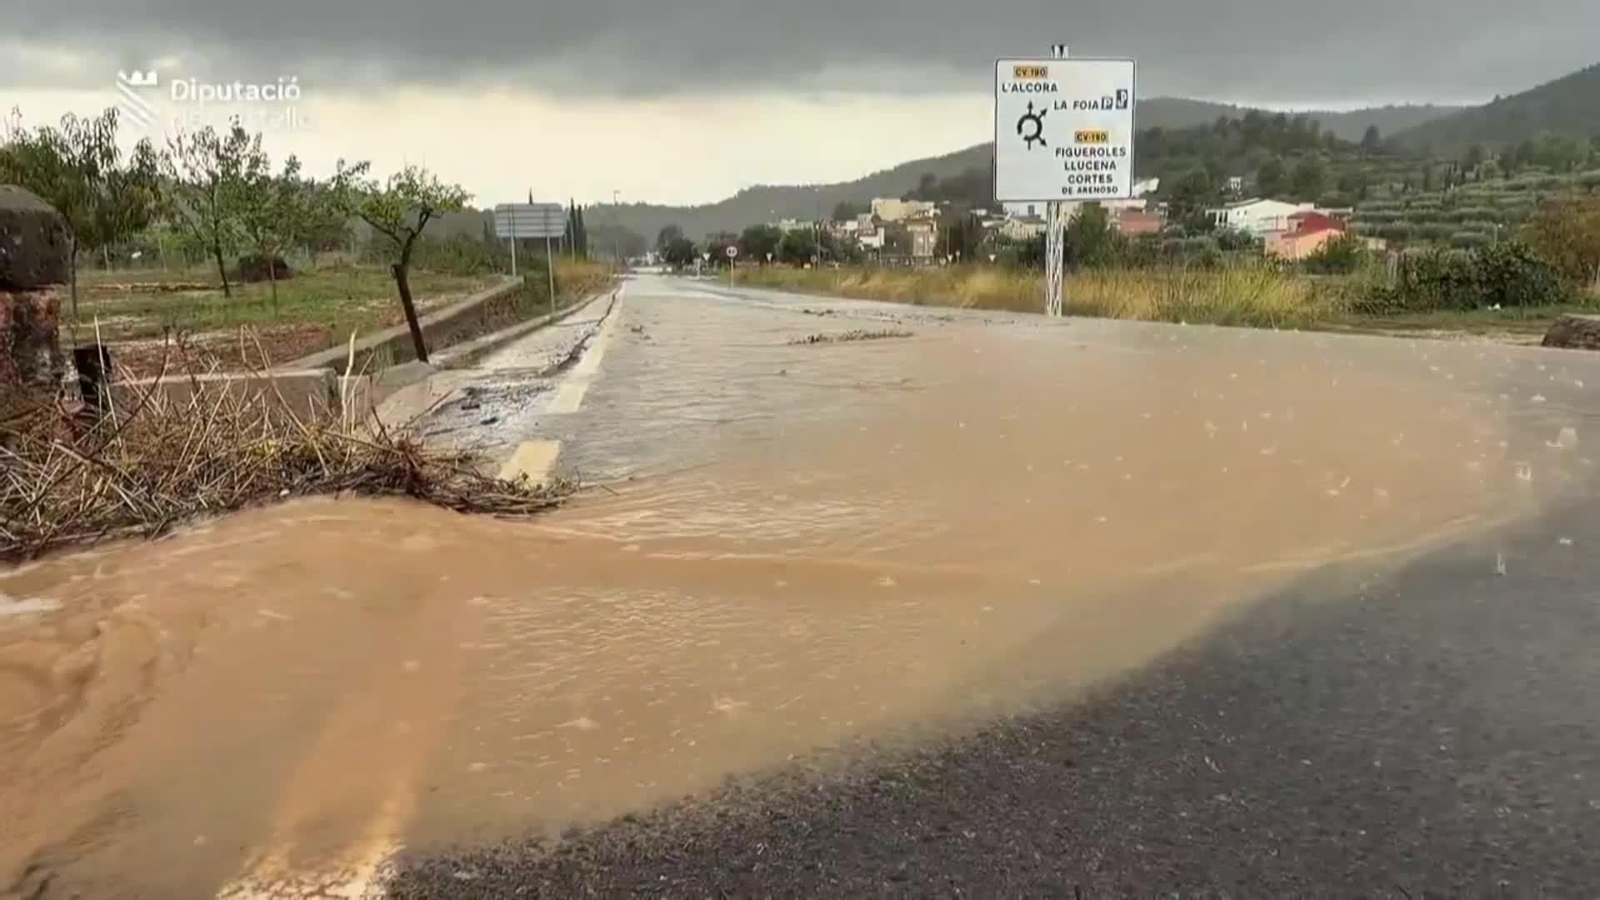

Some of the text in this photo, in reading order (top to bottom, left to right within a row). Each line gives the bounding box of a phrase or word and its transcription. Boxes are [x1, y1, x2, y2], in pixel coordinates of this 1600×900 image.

[1002, 82, 1058, 94] L'ALCORA
[1054, 100, 1067, 111] LA
[1073, 100, 1099, 111] FOIA
[1055, 146, 1127, 158] FIGUEROLES
[1064, 160, 1117, 171] LLUCENA
[1067, 174, 1114, 185] CORTES
[1061, 186, 1119, 195] DE ARENOSO
